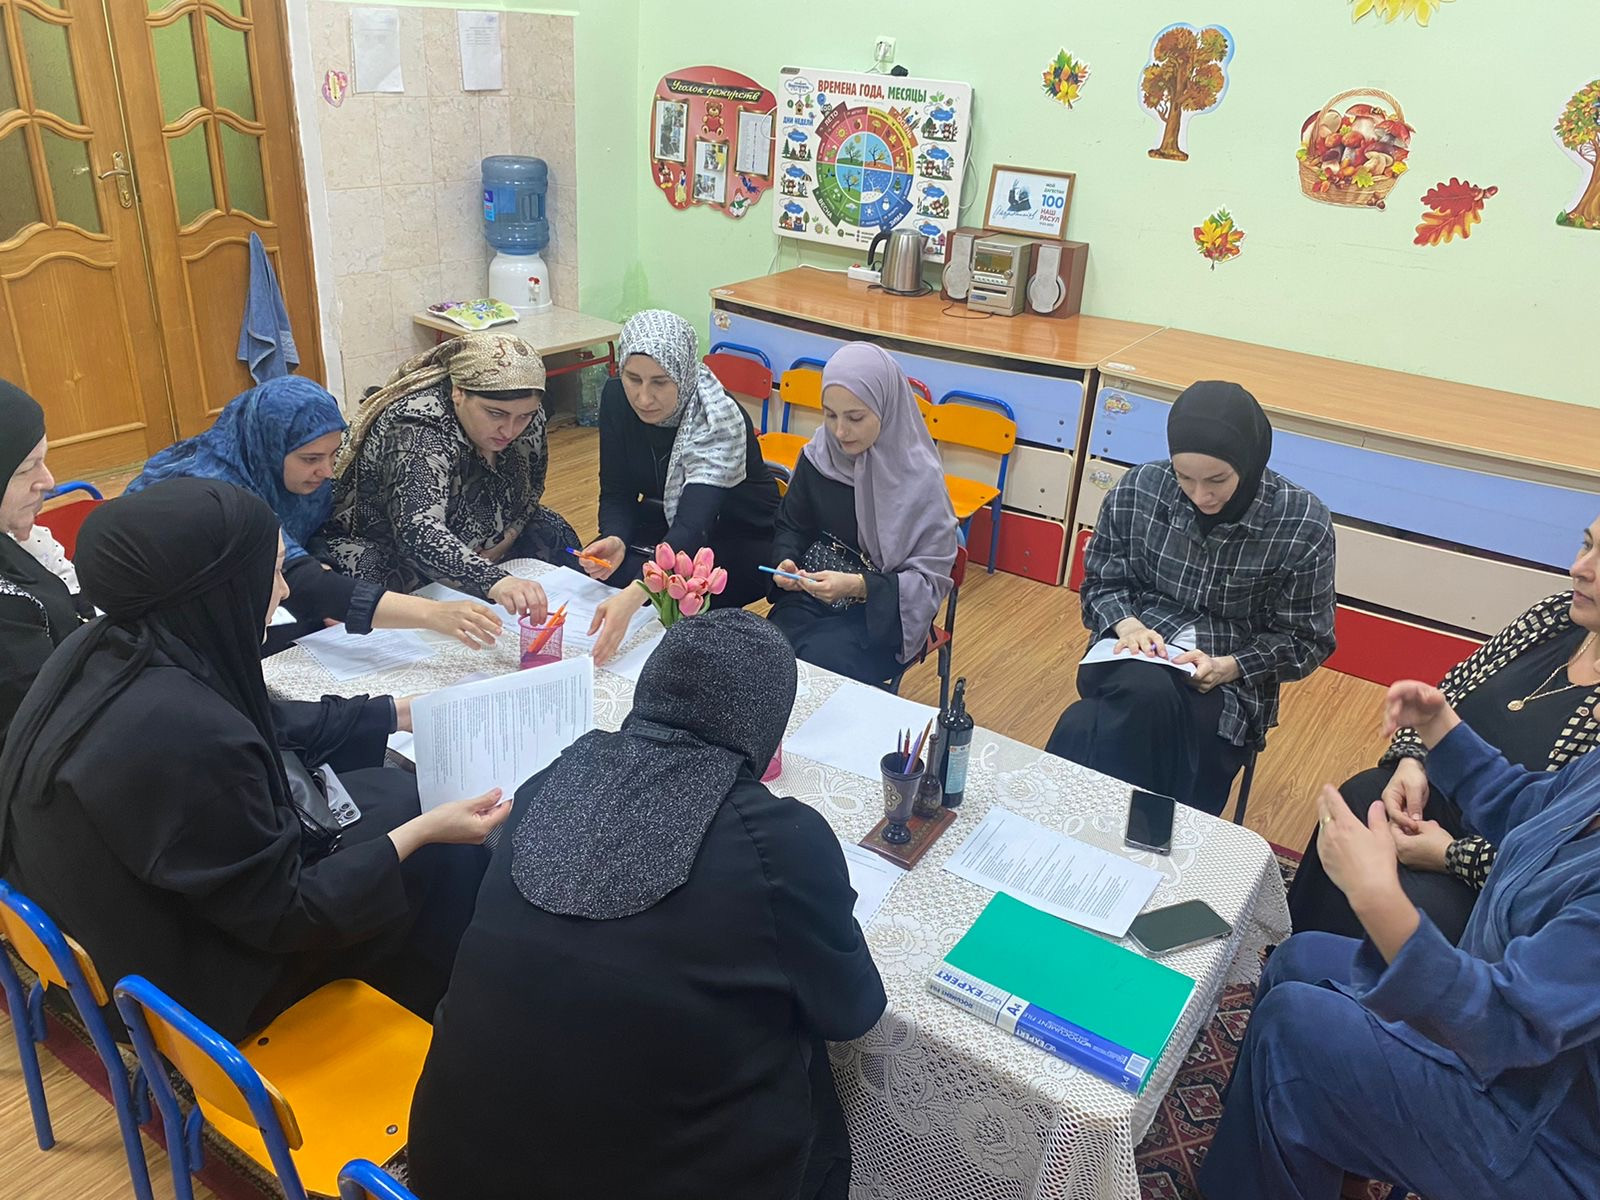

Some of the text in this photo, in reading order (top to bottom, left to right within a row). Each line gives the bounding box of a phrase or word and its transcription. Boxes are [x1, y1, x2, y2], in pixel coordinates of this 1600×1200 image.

[671, 80, 760, 100] Уголок дежурств
[817, 79, 857, 96] ВРЕМЕНА
[859, 85, 885, 99] ГОДА,
[888, 86, 927, 103] МЕСЯЦЫ
[783, 116, 814, 127] ДНИ НЕДЕЛИ
[824, 111, 839, 126] ЛЕТО
[896, 116, 913, 139] ОСЕНЬ
[818, 198, 833, 219] ВЕСНА
[1042, 194, 1064, 209] 100
[889, 212, 904, 227] ЗИМА
[1039, 214, 1060, 224] РАСУЛ
[1040, 208, 1056, 216] НАШ
[935, 970, 983, 997] EXPERT
[1015, 1029, 1045, 1046] EXPERT
